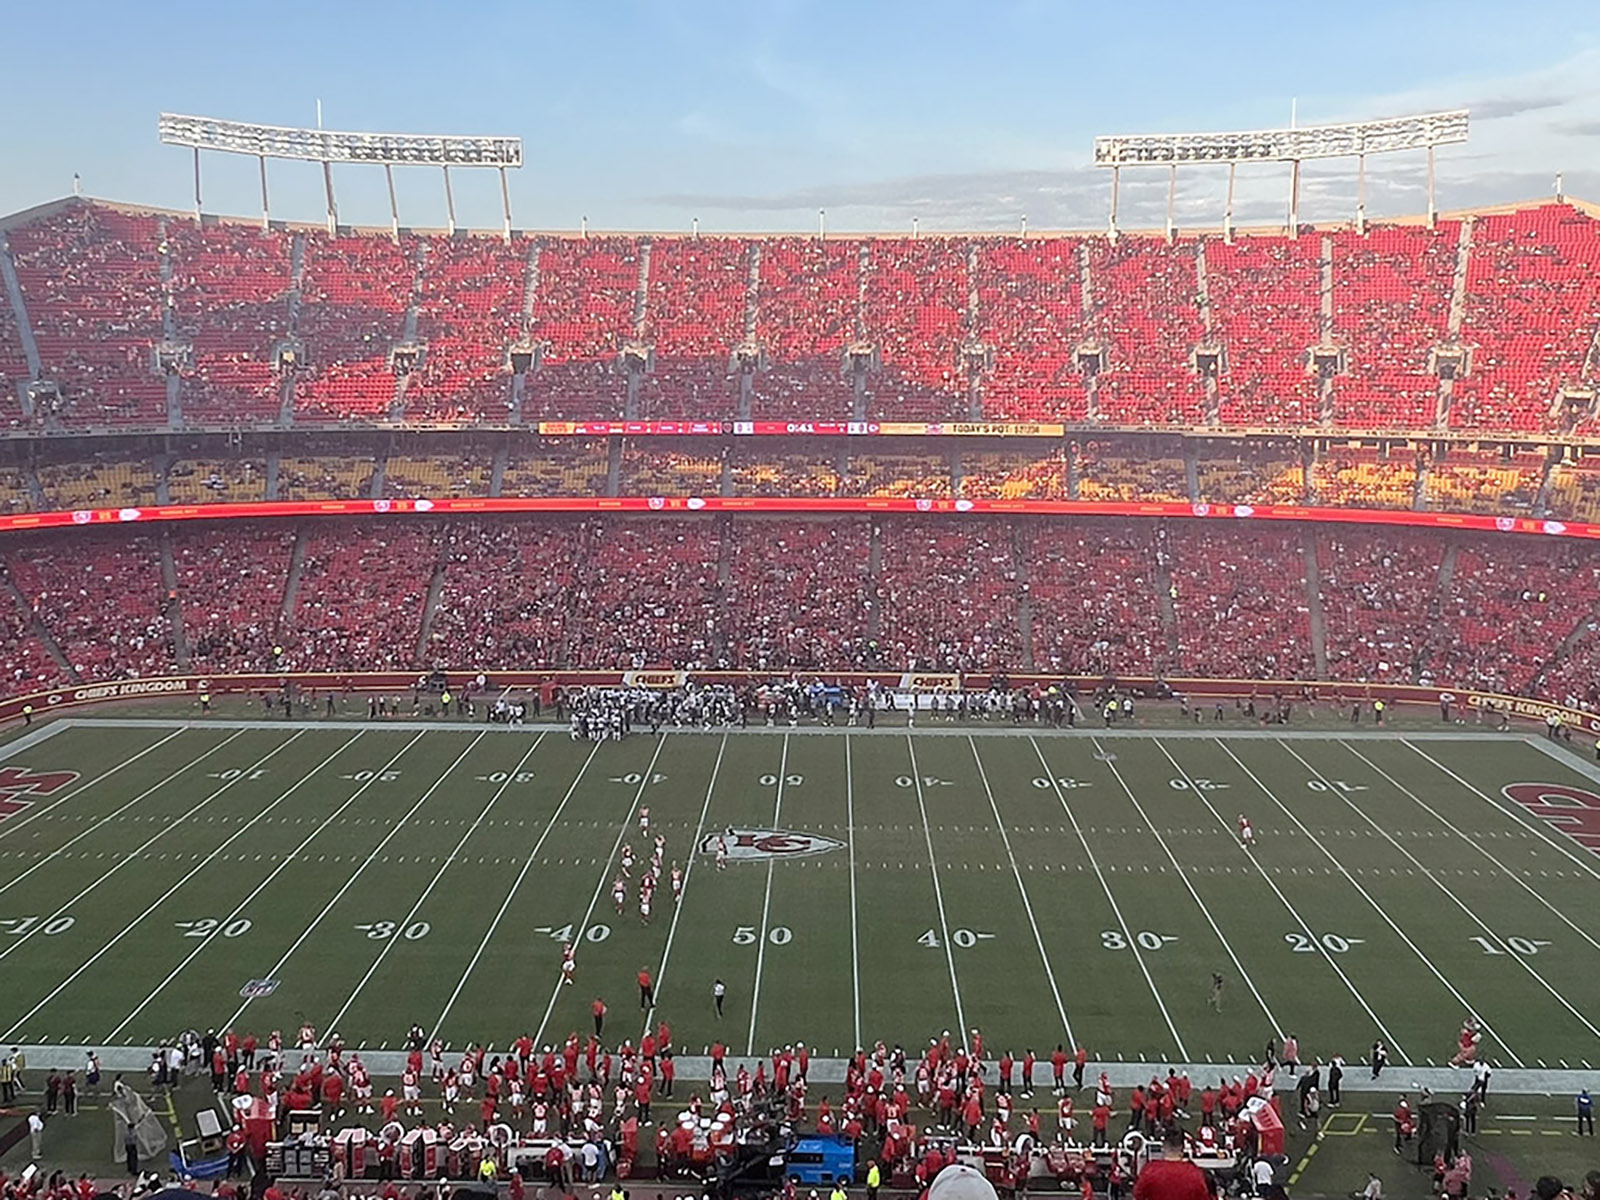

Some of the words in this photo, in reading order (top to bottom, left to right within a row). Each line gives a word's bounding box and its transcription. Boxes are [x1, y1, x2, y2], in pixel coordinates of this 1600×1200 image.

[953, 424, 989, 434] TODAY'S
[74, 685, 118, 700] CHIEFS
[119, 680, 188, 695] KINGDOM
[4, 916, 76, 935] 10
[183, 918, 253, 939] 20
[366, 920, 431, 940] 30
[549, 923, 612, 943] 40
[732, 926, 793, 945] 50
[917, 928, 977, 948] 40
[1100, 930, 1163, 951] 30
[1284, 933, 1350, 953] 20
[1469, 936, 1540, 956] 10
